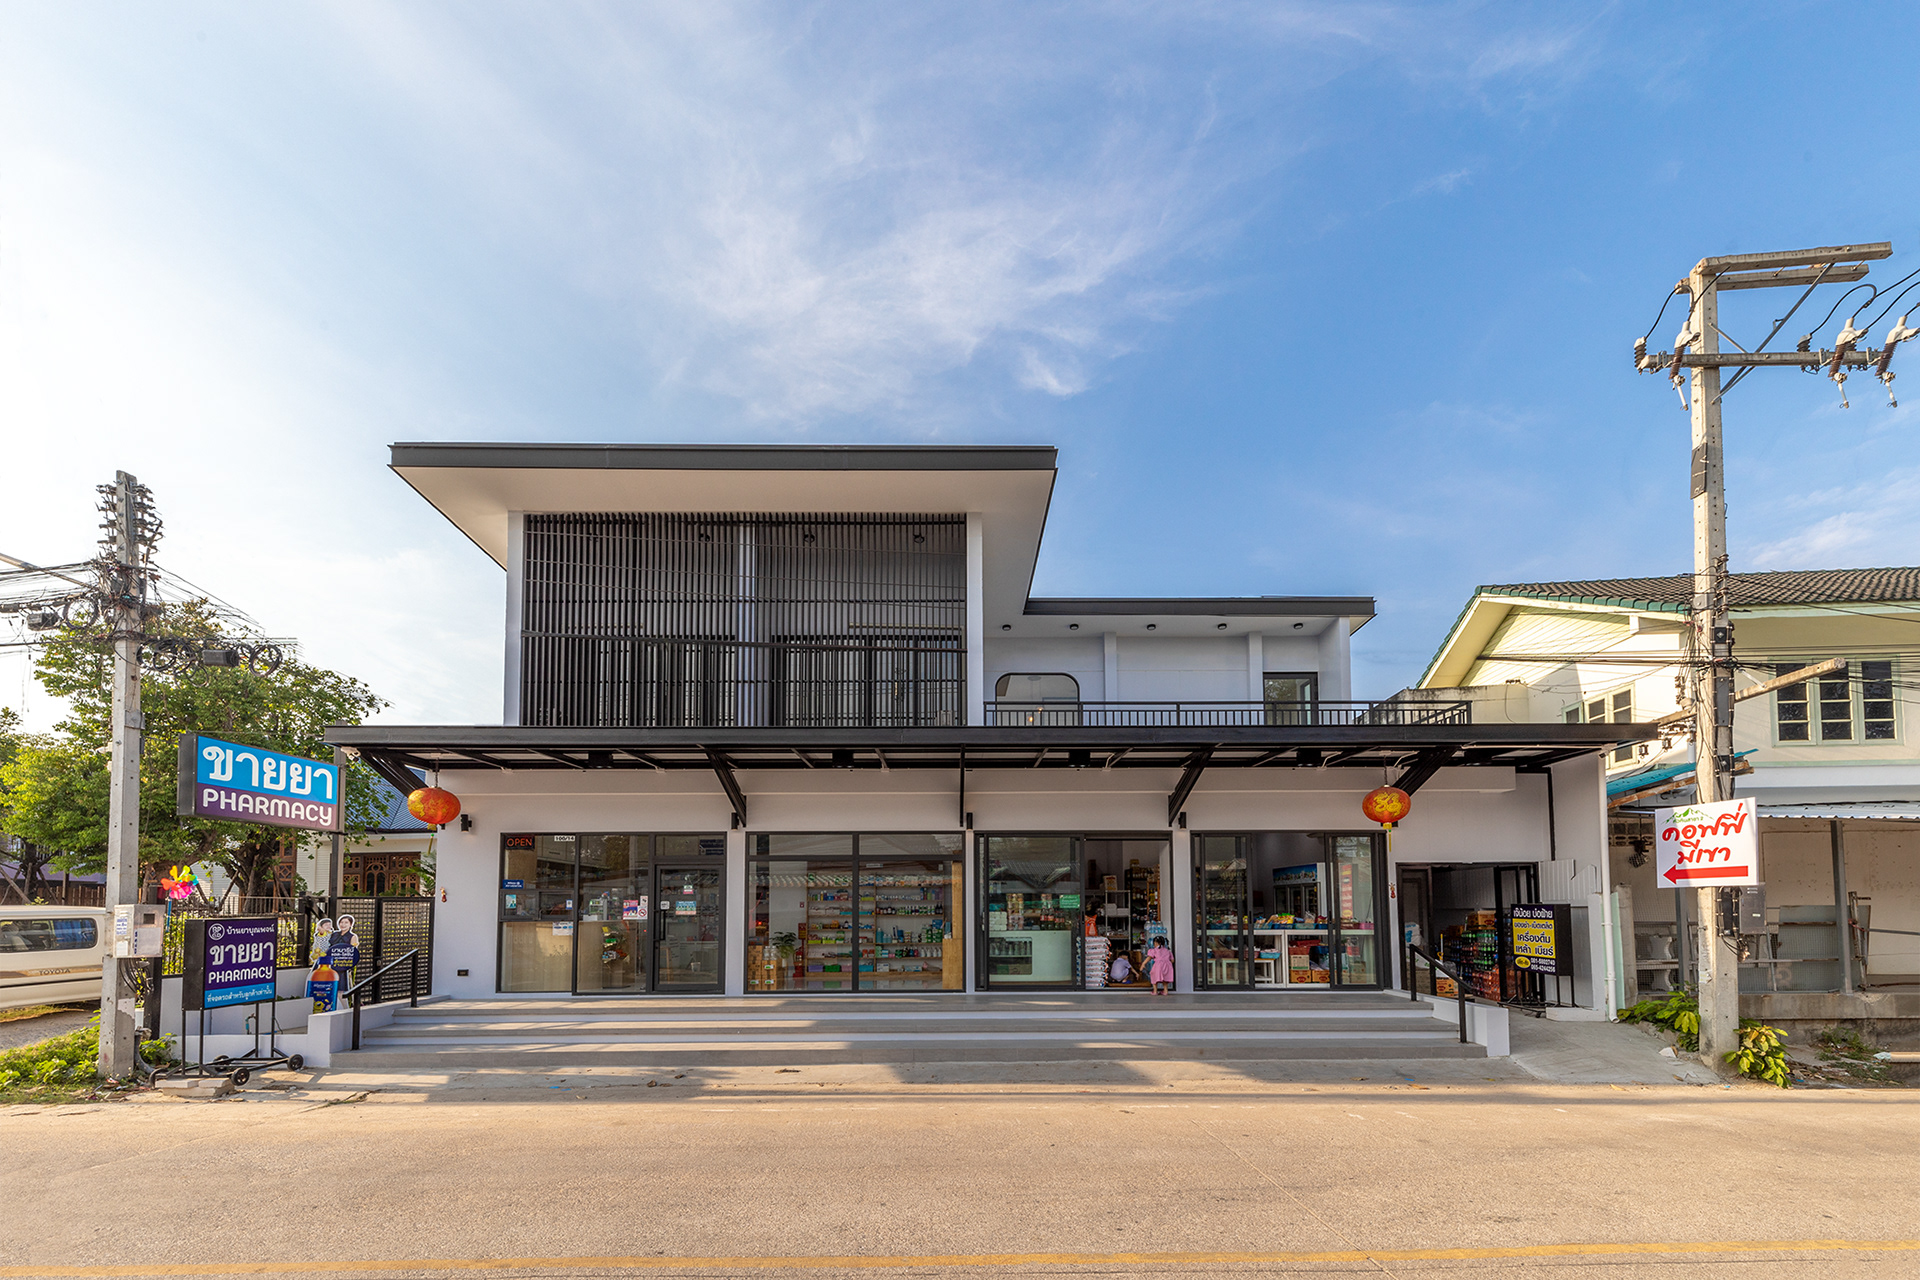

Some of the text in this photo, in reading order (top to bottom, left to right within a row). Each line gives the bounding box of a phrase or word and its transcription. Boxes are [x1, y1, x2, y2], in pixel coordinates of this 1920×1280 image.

[202, 745, 333, 799] ขายยา
[202, 788, 333, 826] PHARMACY
[1662, 803, 1748, 841] คอฟฟี่
[506, 838, 532, 847] OPEN
[1677, 839, 1731, 865] มีเขา
[1513, 907, 1553, 919] เจ๊น้อย บ่อฝ้าย
[1517, 930, 1551, 943] เครื่องดื่ม
[209, 941, 274, 966] ขายยา
[1515, 944, 1554, 956] เหล้า เบียร์
[39, 968, 71, 976] TOYOTA
[208, 966, 273, 985] PHARMACY
